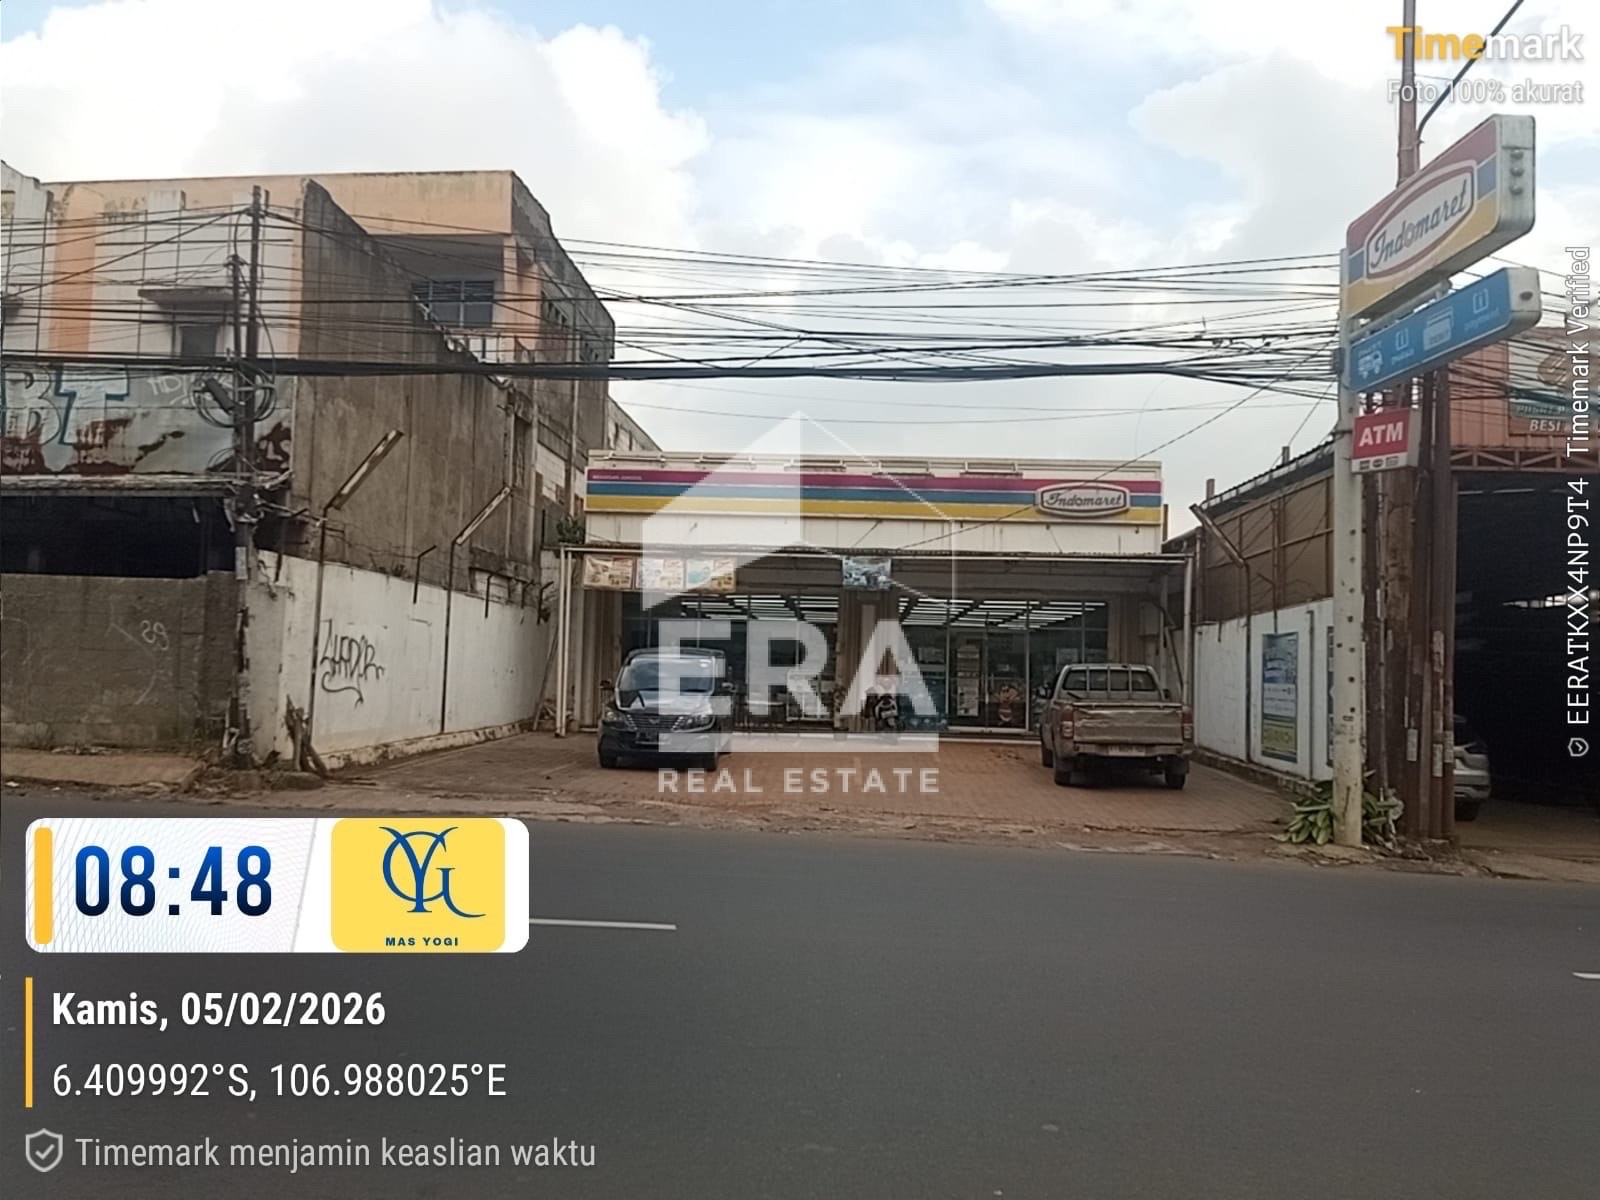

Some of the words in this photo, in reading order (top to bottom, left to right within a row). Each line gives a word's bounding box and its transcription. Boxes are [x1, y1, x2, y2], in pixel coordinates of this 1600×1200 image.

[1370, 178, 1468, 269] Indomaret
[1358, 420, 1405, 448] ATM
[1529, 419, 1561, 432] BESI
[1044, 491, 1122, 508] Indomaret
